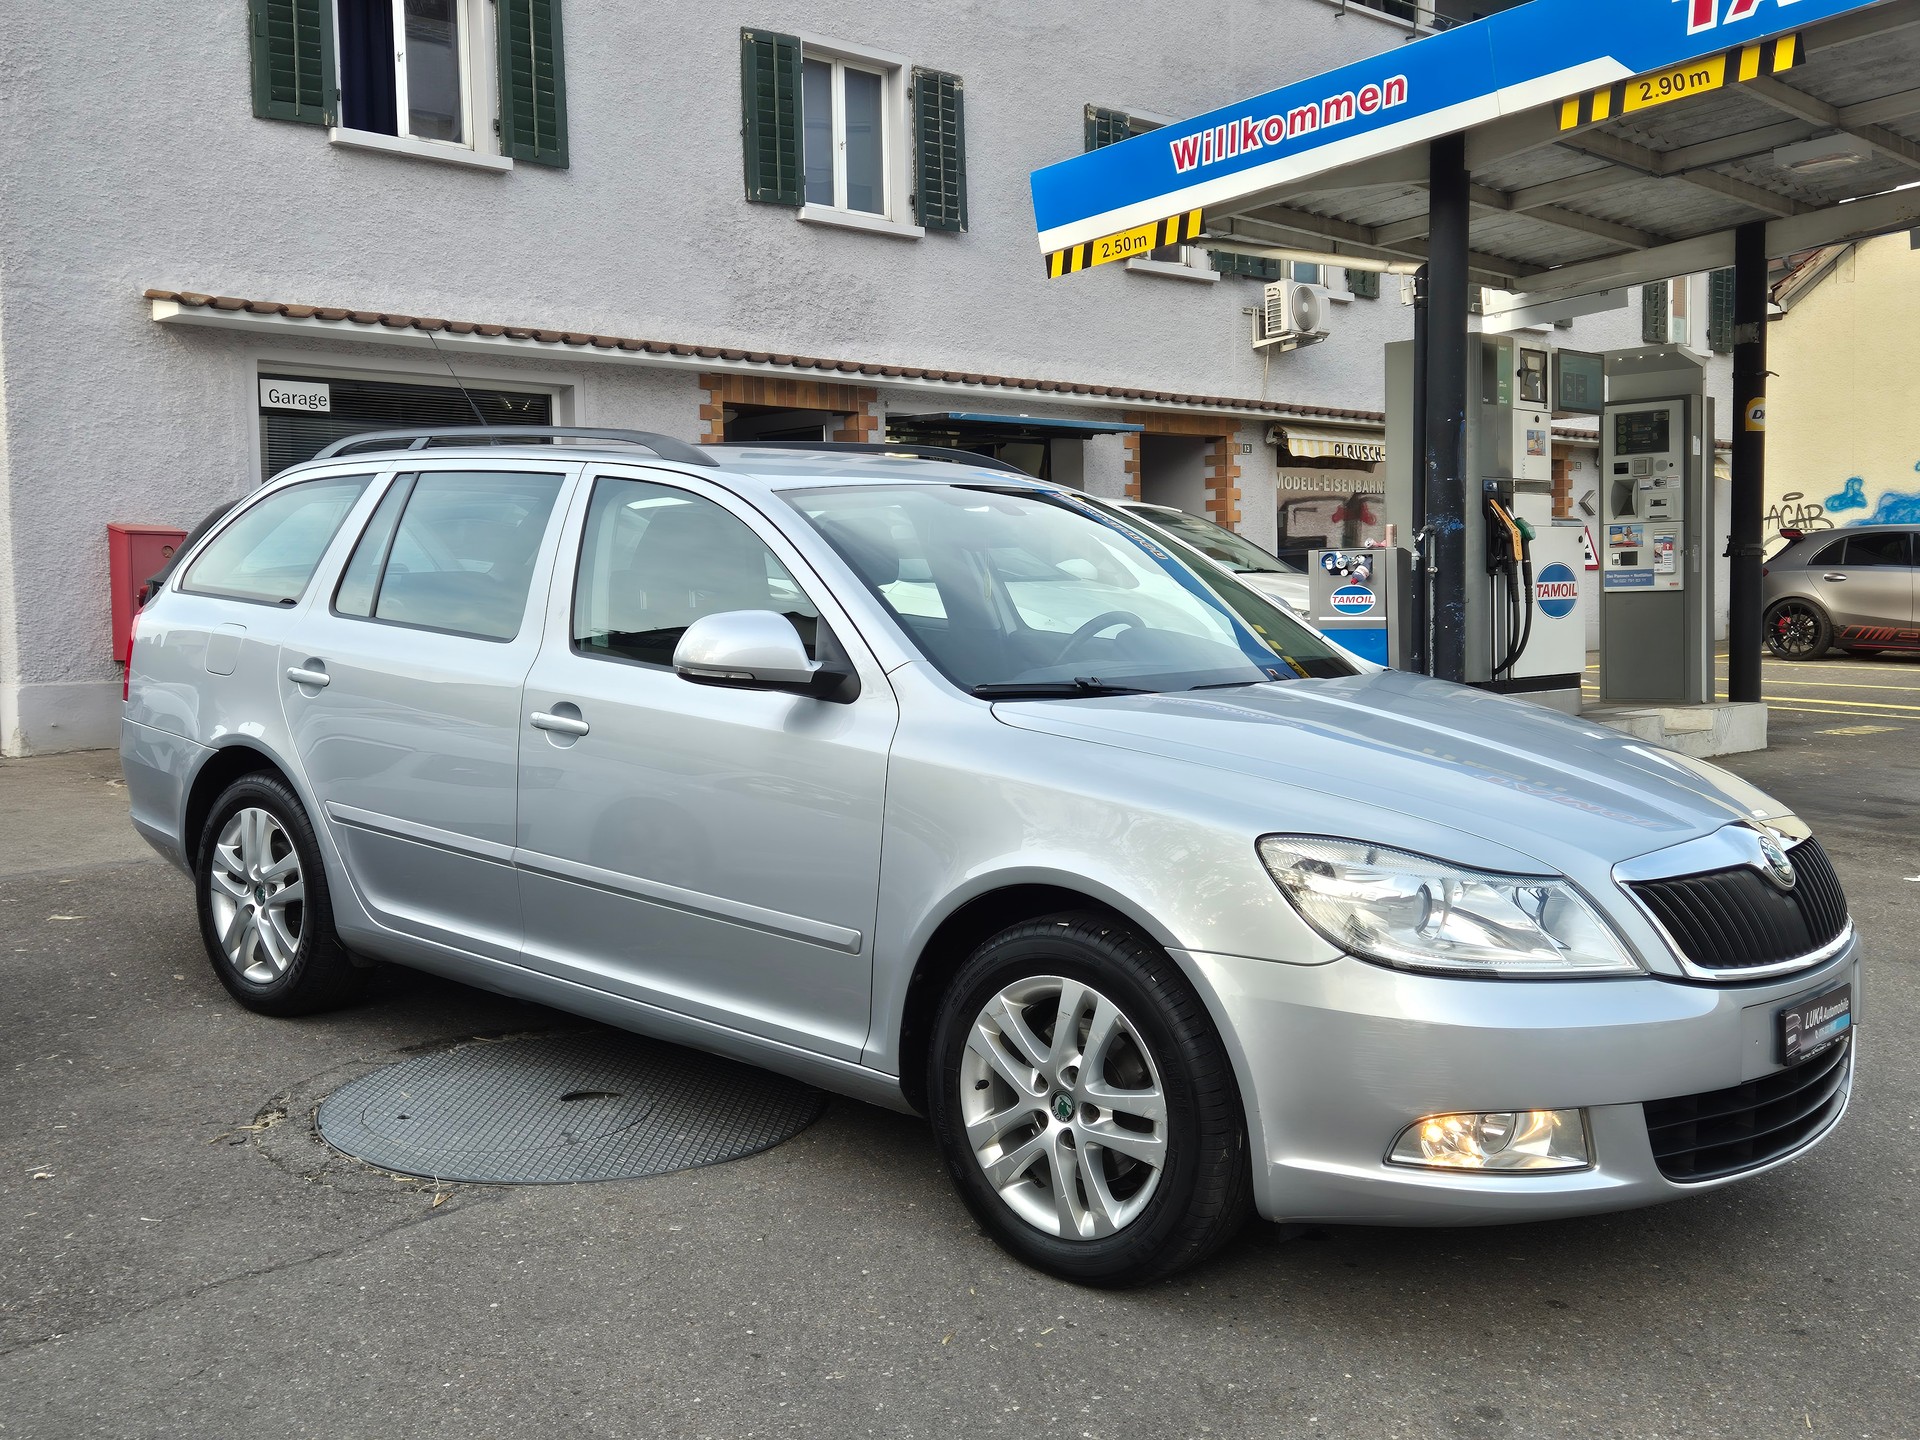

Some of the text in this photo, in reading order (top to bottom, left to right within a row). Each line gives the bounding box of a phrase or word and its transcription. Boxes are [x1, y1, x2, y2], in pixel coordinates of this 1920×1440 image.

[1639, 70, 1711, 101] 2.90 m
[1170, 74, 1408, 174] Willkommen
[1101, 235, 1147, 258] 2.50 m
[268, 388, 328, 410] Garage
[1277, 472, 1386, 494] MODELL-EISENBAHN
[1332, 595, 1374, 604] TAMOIL
[1536, 583, 1578, 598] TAMOIL
[1804, 1005, 1823, 1030] LUKA
